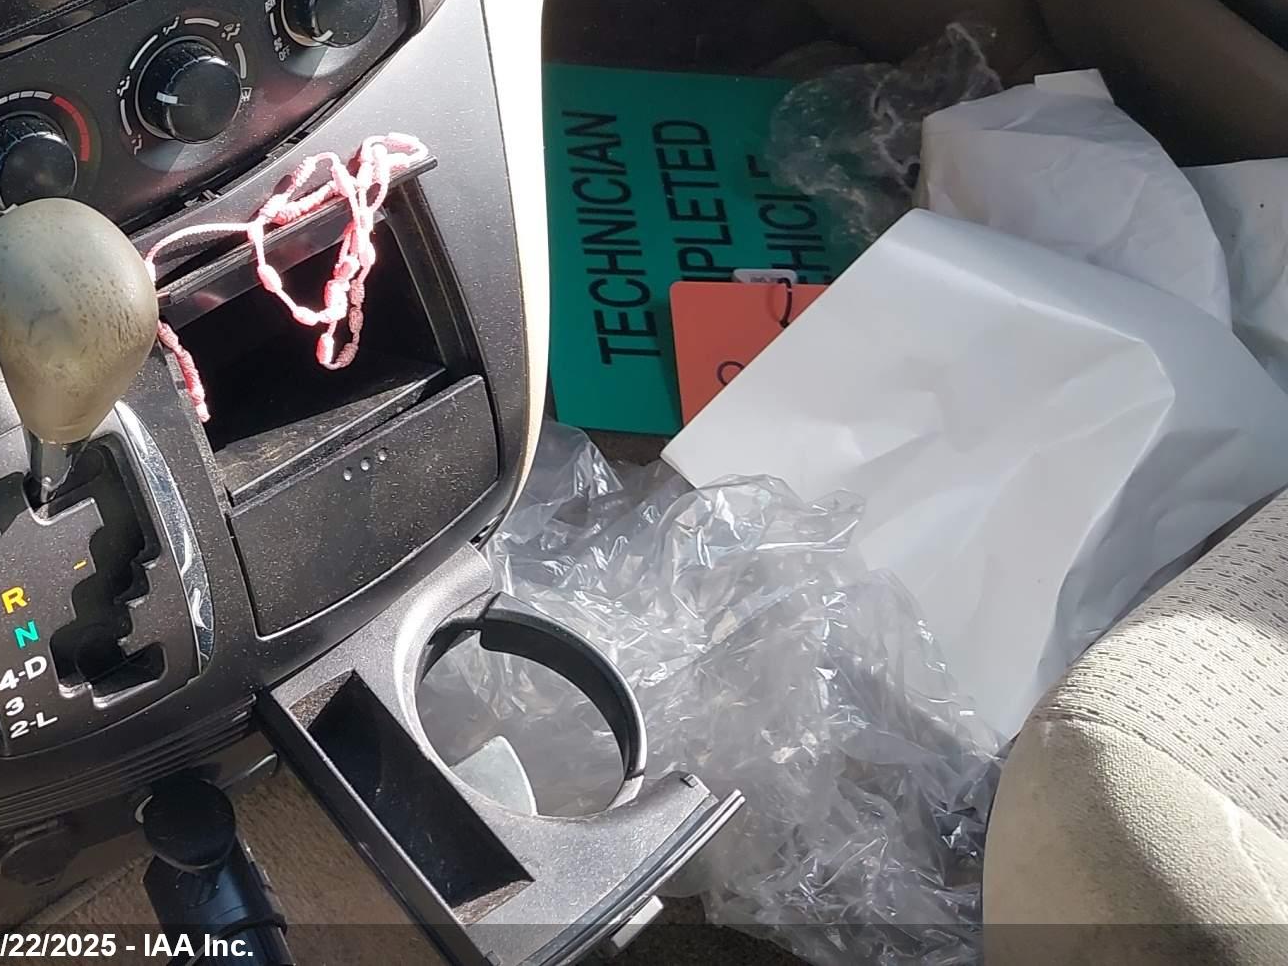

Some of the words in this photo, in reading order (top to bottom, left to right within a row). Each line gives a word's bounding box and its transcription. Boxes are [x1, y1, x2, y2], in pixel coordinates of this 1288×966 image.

[651, 119, 734, 283] PLETED
[561, 109, 663, 365] TECHNICIAN
[0, 586, 28, 614] R
[14, 619, 40, 649] N
[4, 696, 25, 717] 3
[10, 711, 58, 739] 2-L
